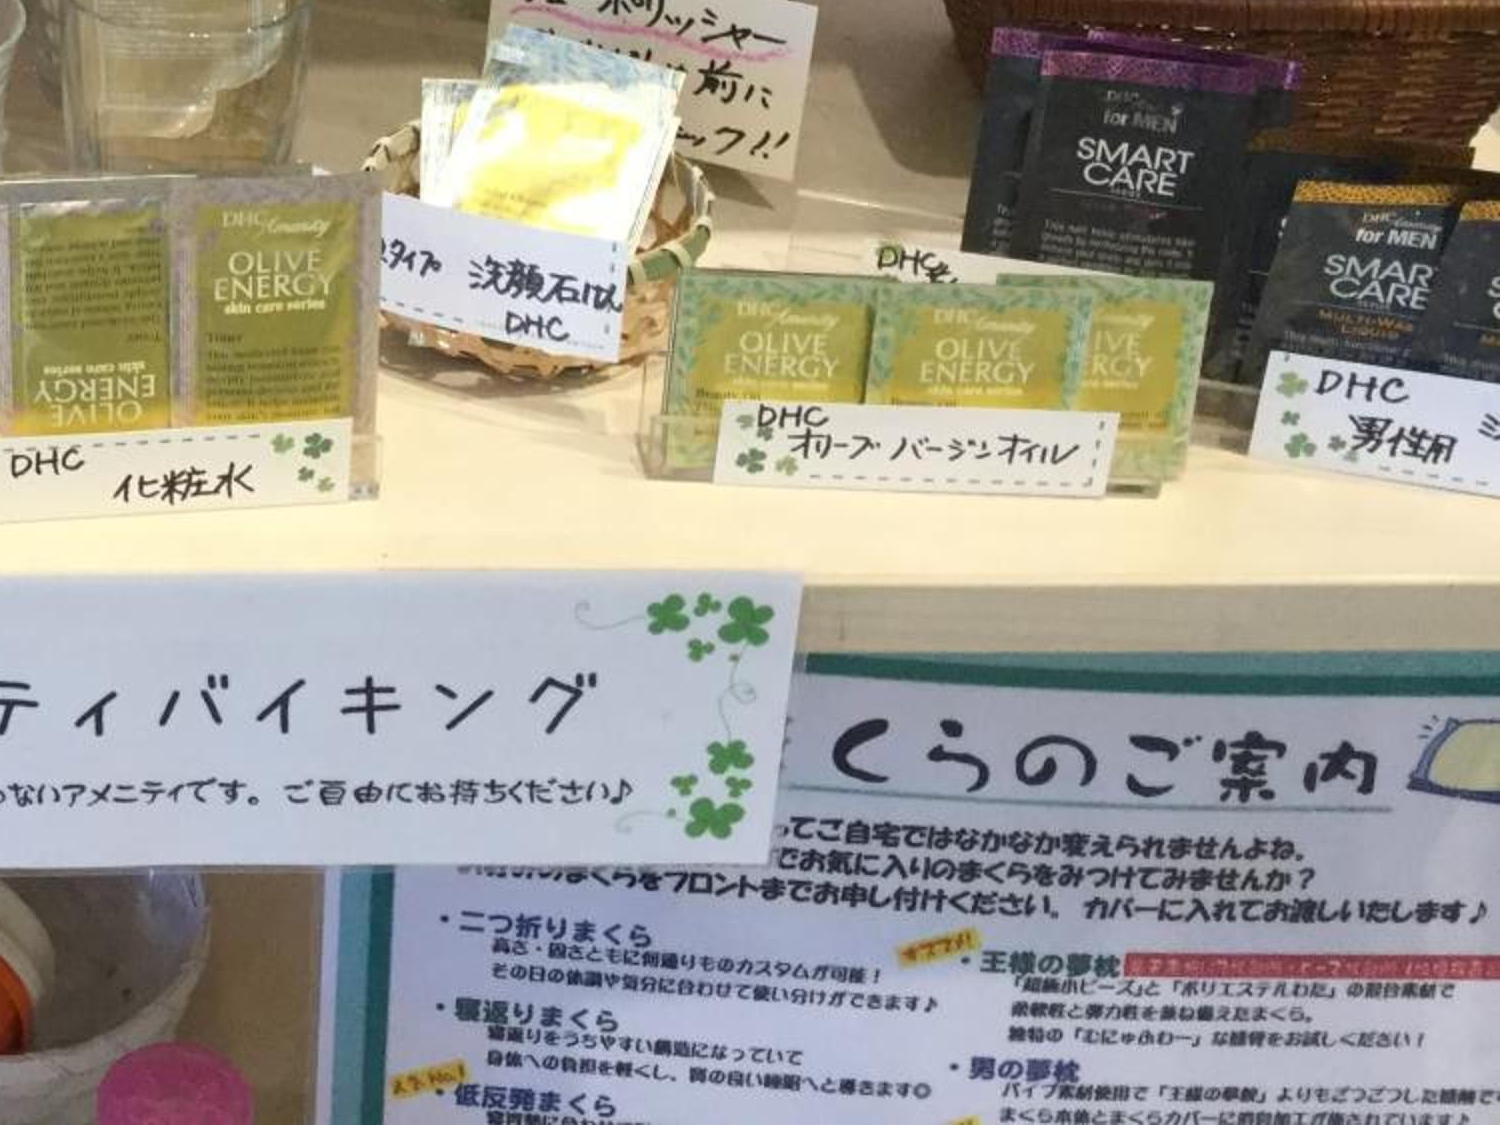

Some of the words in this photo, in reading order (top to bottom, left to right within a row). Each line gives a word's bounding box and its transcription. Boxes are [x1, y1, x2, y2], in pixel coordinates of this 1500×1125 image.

[1103, 110, 1130, 126] for
[1133, 113, 1178, 135] MEN
[1076, 136, 1196, 175] SMART
[1083, 161, 1179, 197] CARE
[222, 210, 267, 228] DHC
[1355, 228, 1384, 244] for
[1387, 230, 1438, 251] MEN
[227, 249, 325, 276] OLIVE
[1323, 253, 1435, 288] SMAR
[213, 272, 335, 302] ENERGY
[1329, 276, 1432, 311] CARE
[224, 302, 252, 316] skin
[255, 300, 285, 314] care
[287, 297, 326, 311] series
[505, 310, 571, 342] DHC
[739, 331, 828, 357] OLIVE
[934, 336, 1023, 362] OLIVE
[118, 361, 146, 375] skin
[723, 353, 839, 379] ENERGY
[918, 360, 1036, 385] ENERGY
[34, 374, 157, 404] ENERGY
[1314, 369, 1411, 405] DHC
[50, 400, 143, 427] OLIVE
[757, 402, 829, 428] DHC
[1349, 413, 1459, 467] 男性用
[10, 446, 86, 478] DHC
[113, 463, 256, 506] 化粧水
